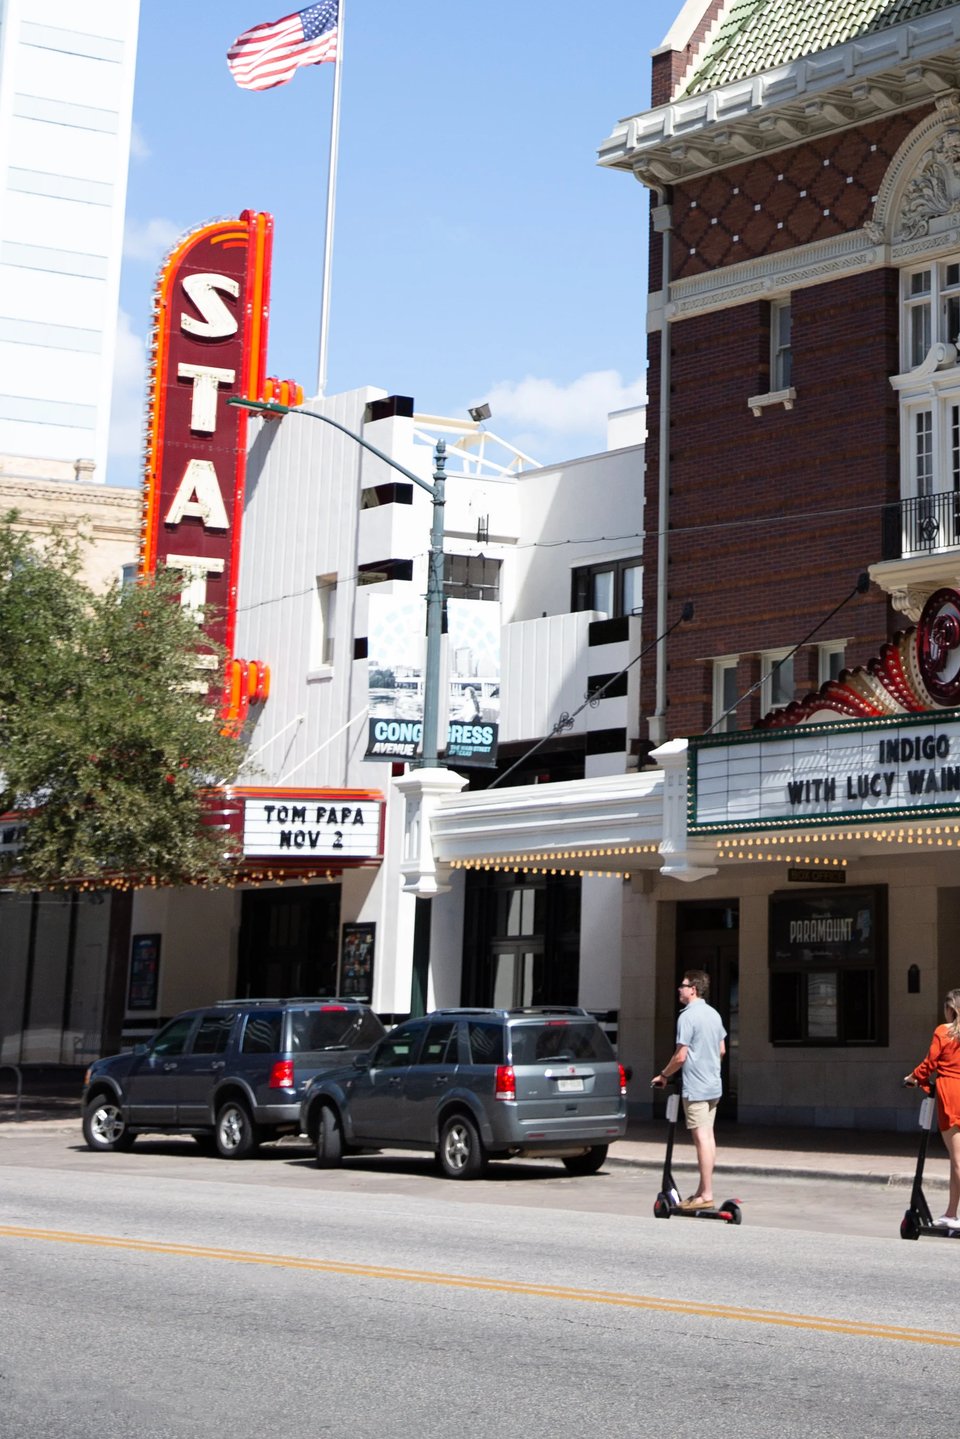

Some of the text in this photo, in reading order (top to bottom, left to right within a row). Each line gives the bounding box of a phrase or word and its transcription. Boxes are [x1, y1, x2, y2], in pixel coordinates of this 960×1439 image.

[372, 742, 415, 756] AVENUE
[878, 734, 950, 764] INDIGO
[787, 777, 836, 805] WITH
[847, 772, 895, 800] LUCY
[264, 804, 364, 825] TOM PAPA
[280, 830, 343, 850] NOV 2
[790, 918, 853, 944] PARAMOUNT
